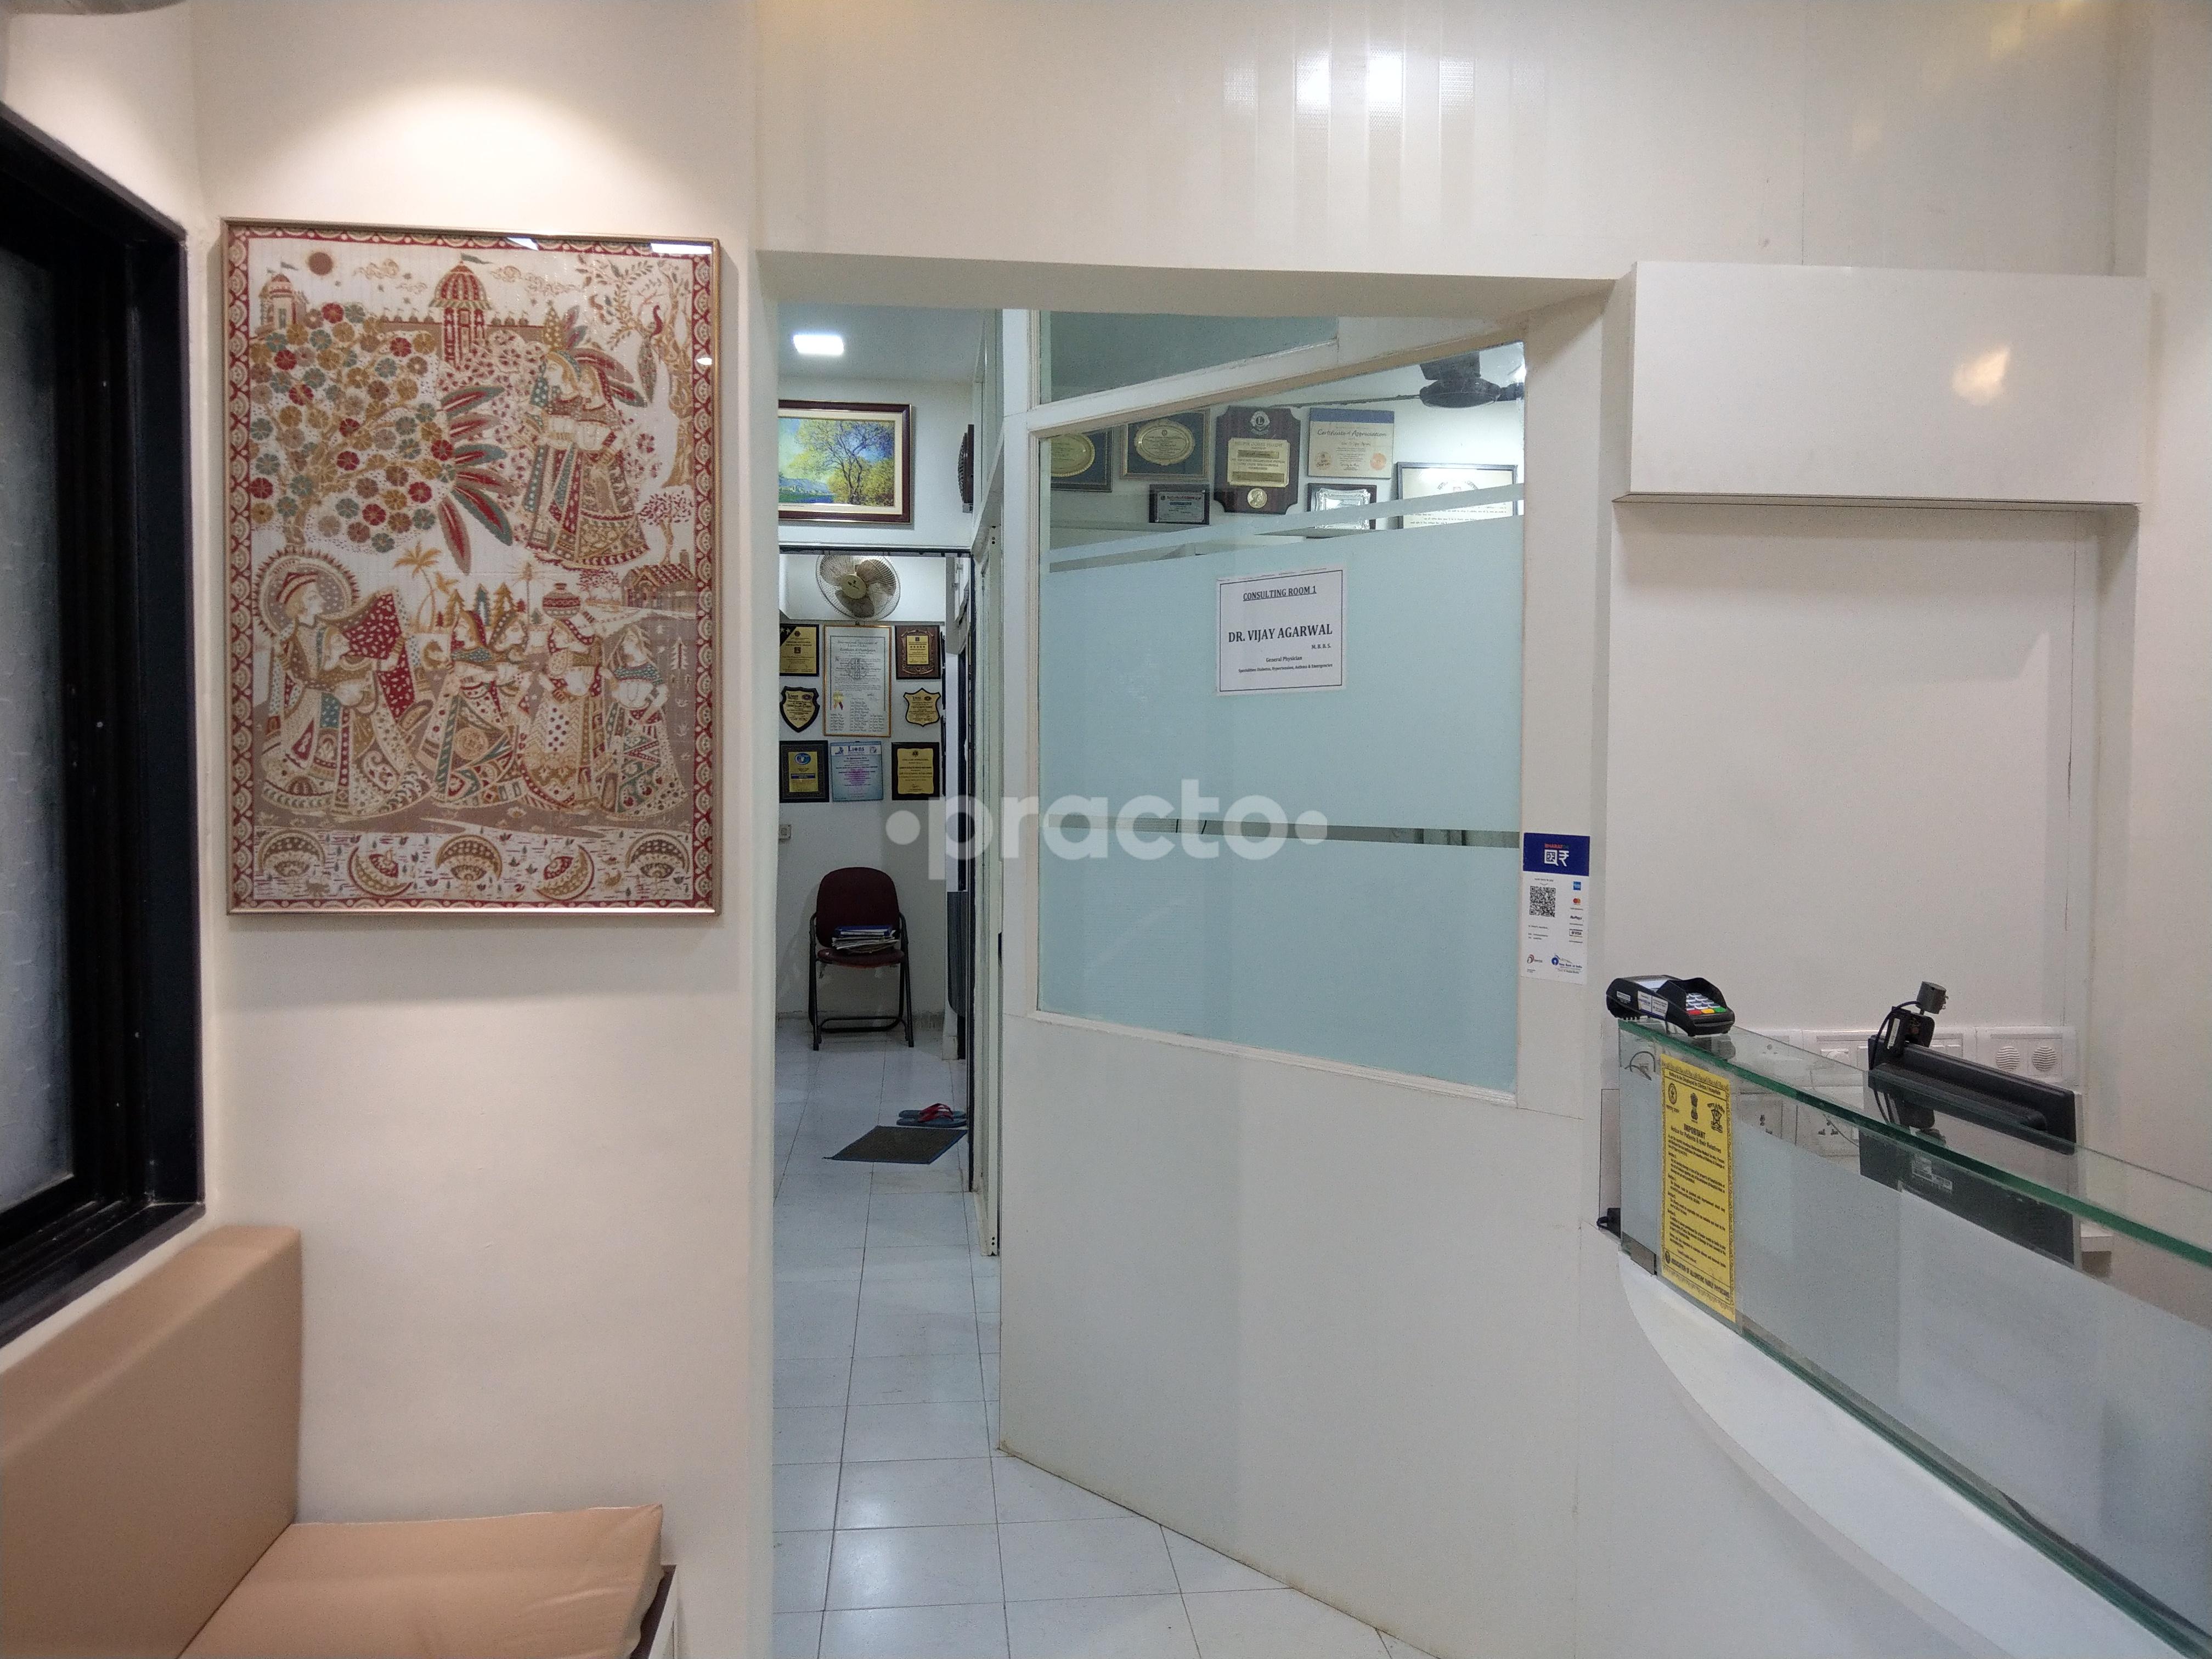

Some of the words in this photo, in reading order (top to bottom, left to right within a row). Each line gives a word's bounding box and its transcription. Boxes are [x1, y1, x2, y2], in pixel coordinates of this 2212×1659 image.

[1243, 589, 1286, 601] CONSULTING
[1289, 586, 1310, 596] ROOM
[1312, 585, 1317, 594] 1
[1228, 631, 1245, 642] DR.
[1248, 628, 1276, 642] VIJAY
[1277, 623, 1333, 638] AGARWAL
[1684, 1123, 1706, 1139] IMPORTANT
